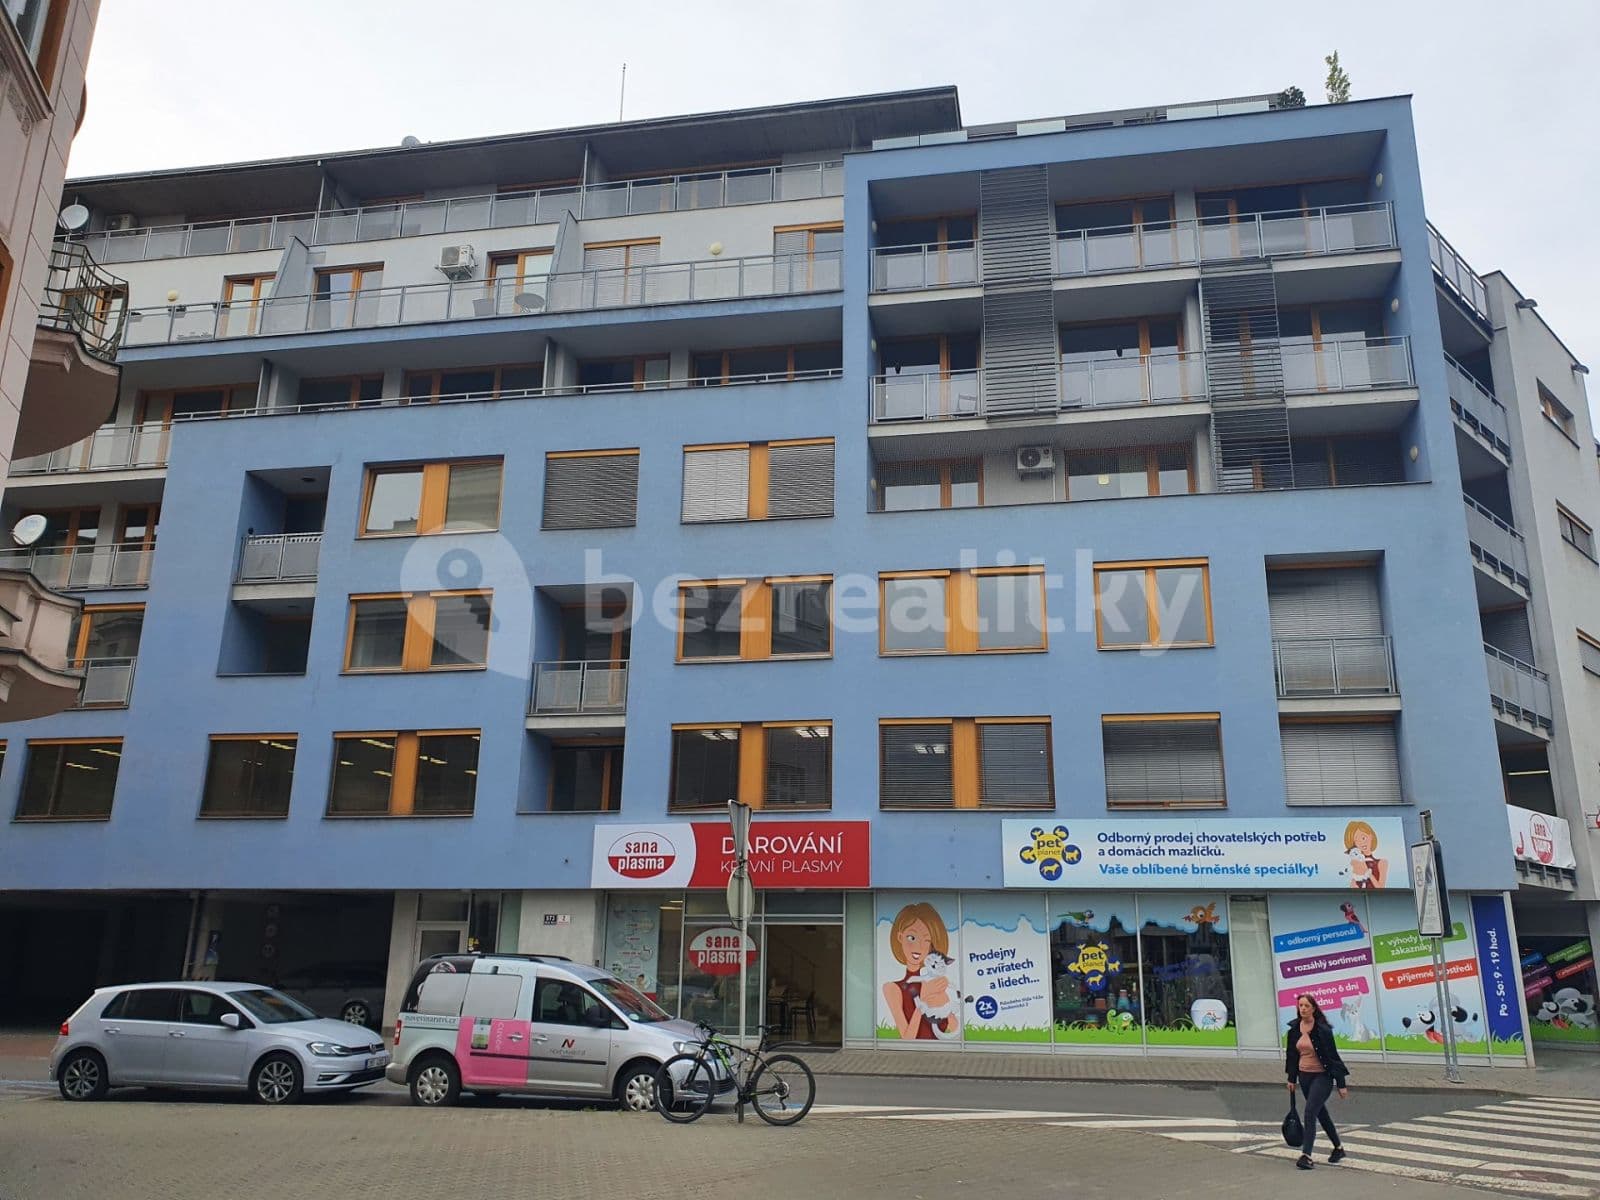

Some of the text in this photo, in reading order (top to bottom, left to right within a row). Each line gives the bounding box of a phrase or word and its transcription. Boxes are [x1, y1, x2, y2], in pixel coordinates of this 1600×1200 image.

[1037, 838, 1062, 849] pet
[1097, 831, 1326, 845] Odborný prodej chovatelských potřeb
[625, 839, 658, 854] sana
[1037, 848, 1061, 857] planet
[1098, 845, 1225, 857] a domácích mazlíčků.
[618, 856, 665, 872] plasma
[720, 858, 843, 873] KVNÍ PLASMY
[1099, 863, 1319, 877] Vaše oblíbené brněnské speciálky!
[705, 936, 740, 949] sana
[1287, 928, 1357, 946] odborný personál
[1387, 934, 1417, 946] výhody
[1487, 928, 1498, 950] hod.
[969, 948, 1016, 962] Prodejny
[1081, 950, 1104, 962] pet
[1390, 943, 1432, 956] zákazníky
[1294, 954, 1367, 972] rozsáhlý sortiment
[1490, 952, 1500, 964] 19
[977, 959, 1034, 976] o zvířatech
[1397, 963, 1473, 984] příjemné rstředí
[989, 974, 1040, 990] a lidech...
[1338, 984, 1344, 992] 6
[1496, 980, 1506, 996] So:
[978, 1001, 992, 1011] 2x
[1500, 1004, 1509, 1016] Po
